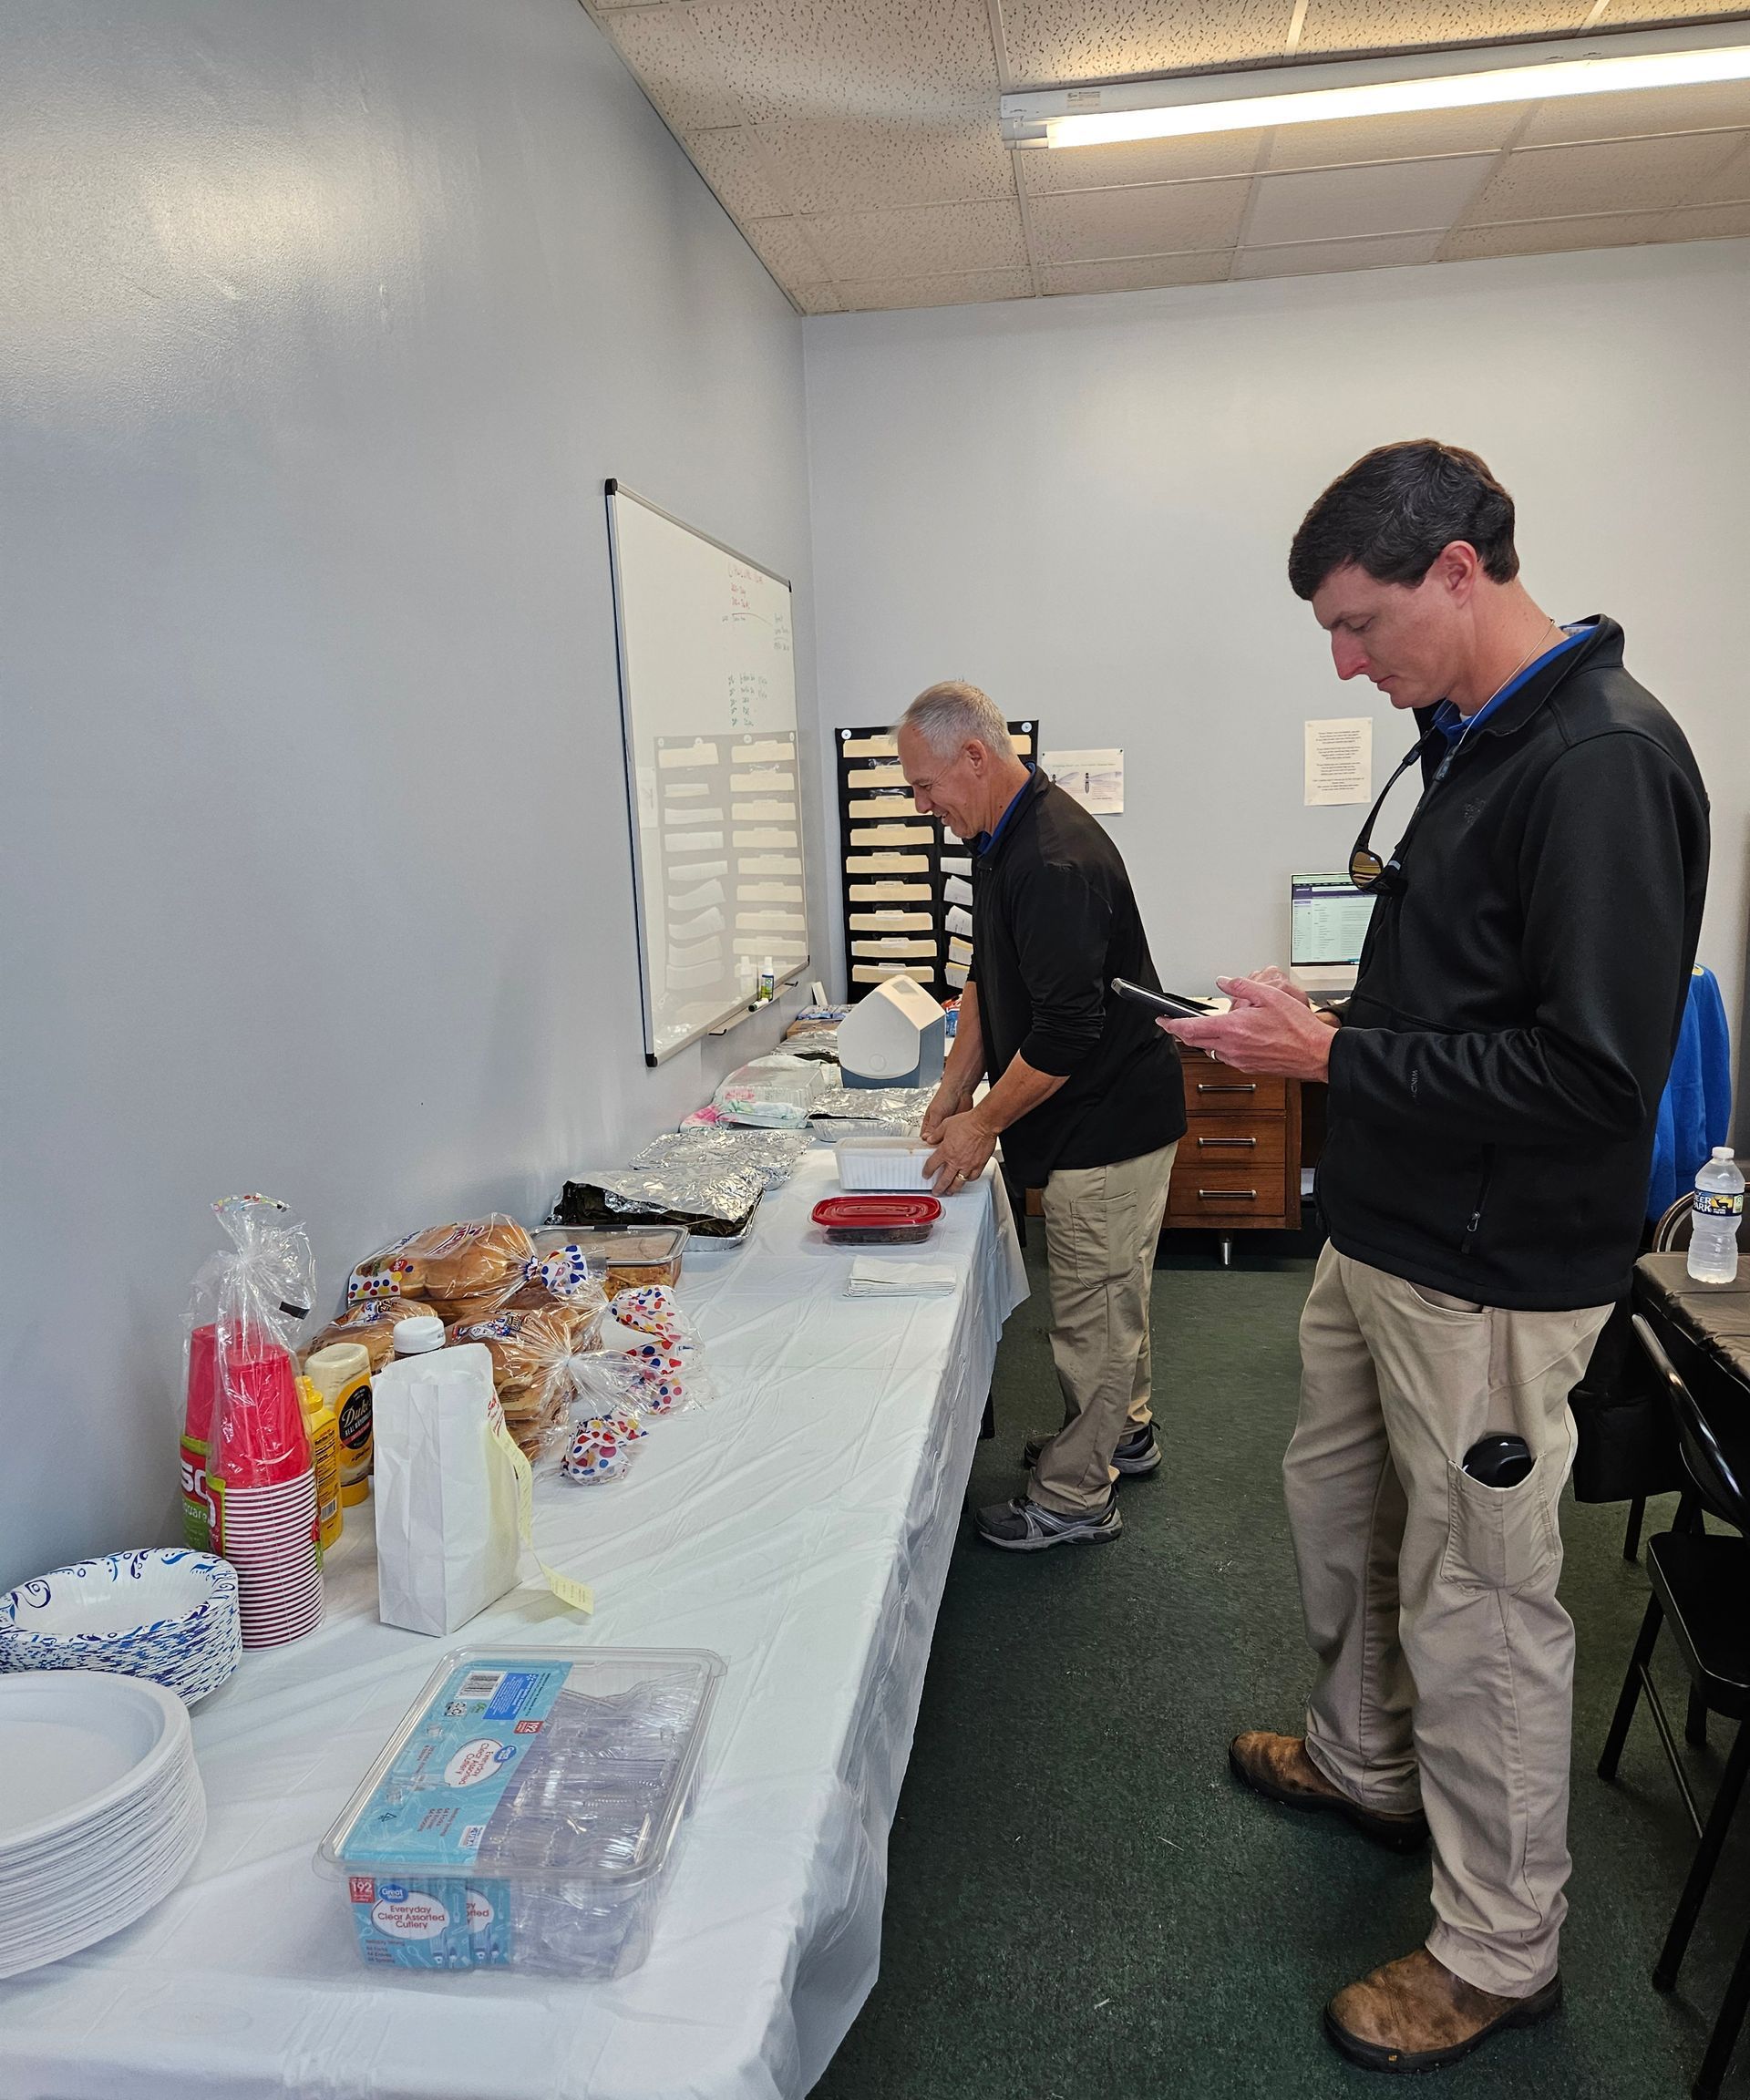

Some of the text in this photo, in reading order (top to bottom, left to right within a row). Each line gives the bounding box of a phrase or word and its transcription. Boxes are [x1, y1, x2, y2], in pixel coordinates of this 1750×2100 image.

[352, 1881, 373, 1893] 192
[390, 1905, 431, 1913] Everyday
[377, 1912, 445, 1921] Clear Assorted
[396, 1920, 428, 1930] Cutlery
